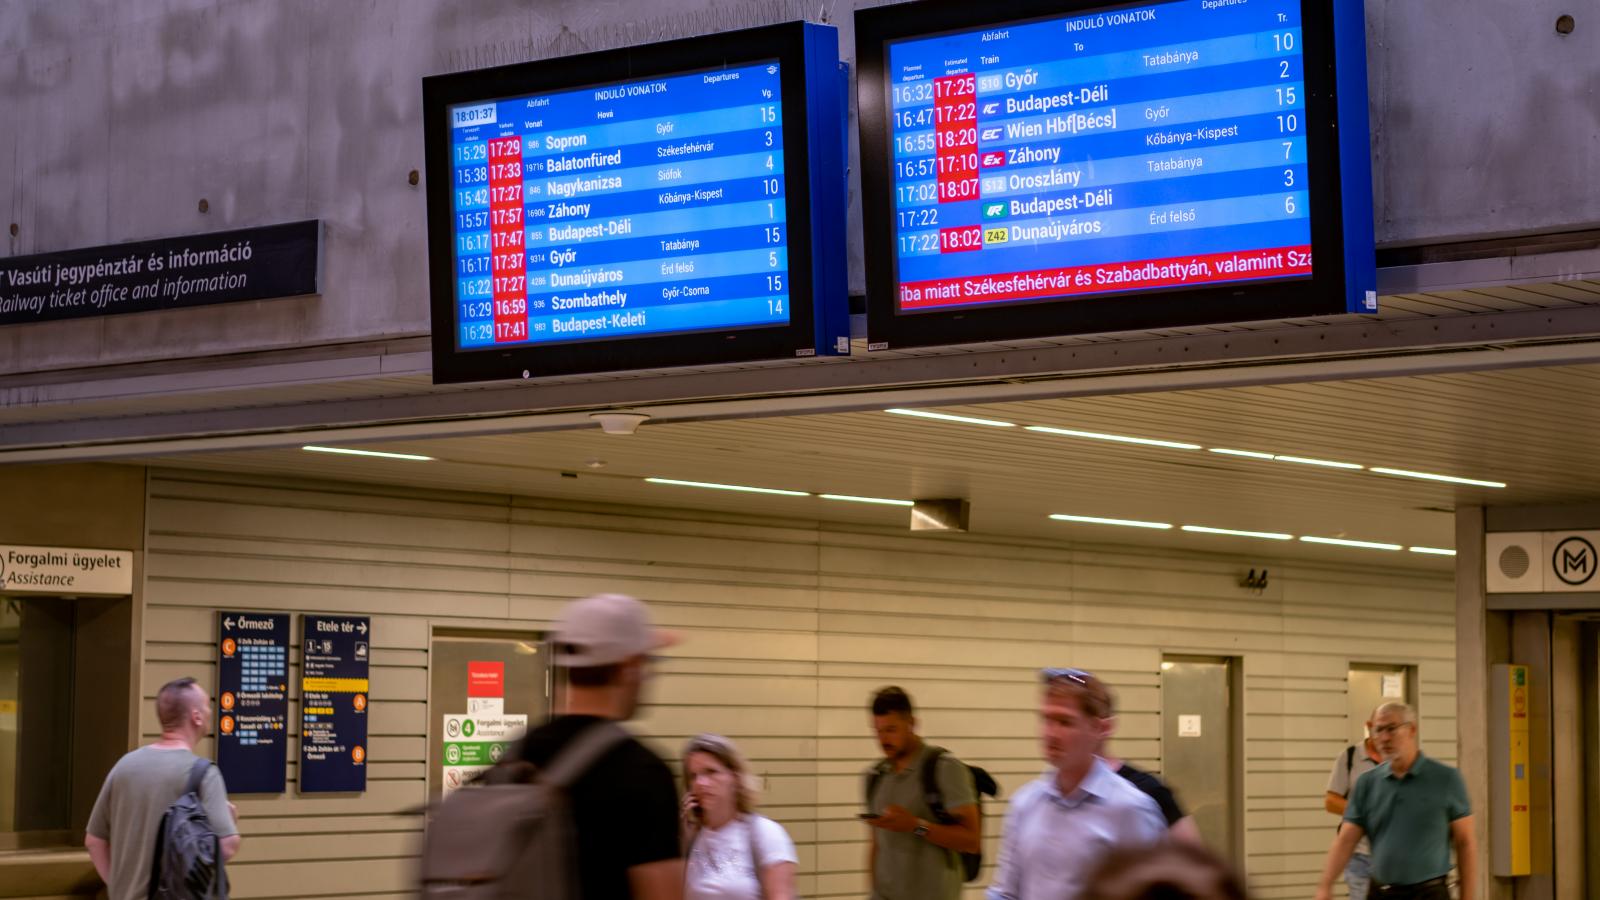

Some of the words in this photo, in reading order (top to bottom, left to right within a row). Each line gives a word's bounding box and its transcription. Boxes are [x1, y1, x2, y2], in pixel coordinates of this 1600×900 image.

[1066, 17, 1104, 32] INDULÓ
[1107, 9, 1156, 26] VONATOK
[1277, 13, 1287, 22] Tr.
[982, 31, 1009, 42] Abfahrt
[1074, 43, 1083, 51] To
[894, 83, 933, 103] 16:32
[935, 78, 975, 98] 17:25
[1005, 69, 1038, 90] Győr
[1143, 50, 1199, 67] Tatabánya
[1273, 32, 1294, 51] 10
[945, 58, 967, 66] Estimated
[946, 68, 968, 76] departure
[980, 55, 999, 65] Train
[595, 85, 625, 100] INDULÓ
[627, 82, 667, 96] VONATOK
[704, 73, 739, 84] Departures
[527, 98, 550, 108] Abfahrt
[762, 89, 773, 98] Vg.
[896, 109, 933, 128] 16:47
[936, 103, 976, 123] 17:22
[983, 103, 999, 114] IC
[1007, 85, 1108, 113] Budapest-Déli
[1280, 60, 1289, 78] 2
[456, 108, 493, 122] 18:01:37
[525, 120, 542, 128] Vonat
[598, 109, 613, 119] Hová
[896, 133, 934, 153] 16:55
[937, 128, 976, 148] 18:20
[982, 129, 1002, 140] EC
[1007, 121, 1042, 139] Wien
[1046, 108, 1116, 134] Hbf[Bécs]
[1145, 106, 1169, 121] Győr
[1276, 87, 1295, 106] 15
[457, 144, 486, 160] 15:29
[490, 140, 520, 157] 17:29
[546, 135, 587, 151] Sopron
[657, 122, 674, 135] Győr
[761, 106, 775, 122] 15
[897, 159, 935, 178] 16:57
[938, 153, 977, 173] 17:10
[984, 154, 1002, 166] Ex
[1008, 146, 1060, 165] Záhony
[1146, 124, 1238, 146] Kőbánya-Kispest
[1277, 114, 1297, 132] 10
[458, 167, 487, 183] 15:38
[491, 162, 521, 180] 17:33
[526, 163, 543, 172] 19716
[547, 150, 621, 172] Balatonfüred
[658, 140, 715, 157] Székesfehérvár
[766, 131, 772, 147] 3
[459, 189, 488, 206] 15:42
[492, 185, 521, 202] 17:27
[547, 176, 622, 197] Nagykanizsa
[658, 169, 682, 181] Siófok
[766, 155, 773, 170] 4
[899, 184, 936, 203] 17:02
[939, 179, 978, 198] 18:07
[1010, 169, 1080, 190] Oroszlány
[1147, 156, 1203, 173] Tatabánya
[1282, 142, 1293, 160] 7
[460, 212, 488, 228] 15:57
[492, 208, 522, 225] 17:57
[548, 203, 590, 218] Záhony
[659, 189, 722, 204] Kőbánya-Kispest
[764, 179, 778, 195] 10
[899, 209, 938, 228] 17:22
[1011, 189, 1112, 216] Budapest-Déli
[1284, 169, 1294, 187] 3
[461, 234, 488, 251] 16:17
[494, 231, 523, 248] 17:47
[549, 219, 631, 241] Budapest-Déli
[768, 203, 773, 219] 1
[901, 234, 938, 252] 17:22
[941, 229, 981, 248] 18:02
[987, 231, 1006, 241] Z42
[1012, 219, 1101, 241] Dunaújváros
[1150, 211, 1166, 225] Érd
[1170, 208, 1195, 222] felső
[1286, 196, 1295, 214] 6
[8, 265, 51, 287] Vasúti
[55, 255, 143, 287] jegypénztár
[148, 252, 164, 272] és
[169, 241, 252, 269] információ
[461, 257, 489, 273] 16:17
[494, 253, 523, 270] 17:37
[530, 255, 544, 263] 9314
[550, 248, 576, 267] Győr
[661, 239, 699, 251] Tatabánya
[765, 227, 780, 242] 15
[462, 280, 491, 295] 16:22
[495, 276, 525, 292] 17:27
[551, 269, 623, 287] Dunaújváros
[662, 262, 674, 275] Érd
[676, 262, 694, 273] felső
[769, 252, 776, 267] 5
[901, 285, 921, 301] iba
[925, 283, 960, 299] miatt
[964, 272, 1071, 296] Székesfehérvár
[1075, 270, 1092, 287] és
[1096, 259, 1212, 285] Szabadbattyán,
[1216, 252, 1283, 273] valamint
[50, 287, 86, 308] ticket
[91, 283, 128, 308] office
[132, 279, 158, 300] and
[163, 272, 247, 299] information
[463, 302, 491, 318] 16:29
[496, 299, 525, 315] 16:59
[552, 290, 626, 310] Szombathely
[662, 286, 709, 300] Győr-Csorna
[767, 276, 781, 291] 15
[464, 324, 492, 340] 16:29
[497, 322, 525, 338] 17:41
[553, 311, 645, 333] Budapest-Keleti
[768, 300, 782, 315] 14
[9, 551, 68, 568] Forgalmi
[73, 553, 121, 571] ügyelet
[7, 571, 75, 586] Assistance
[238, 616, 274, 629] Őrmező
[317, 621, 338, 632] Etele
[342, 622, 354, 633] tér
[465, 723, 471, 733] 4
